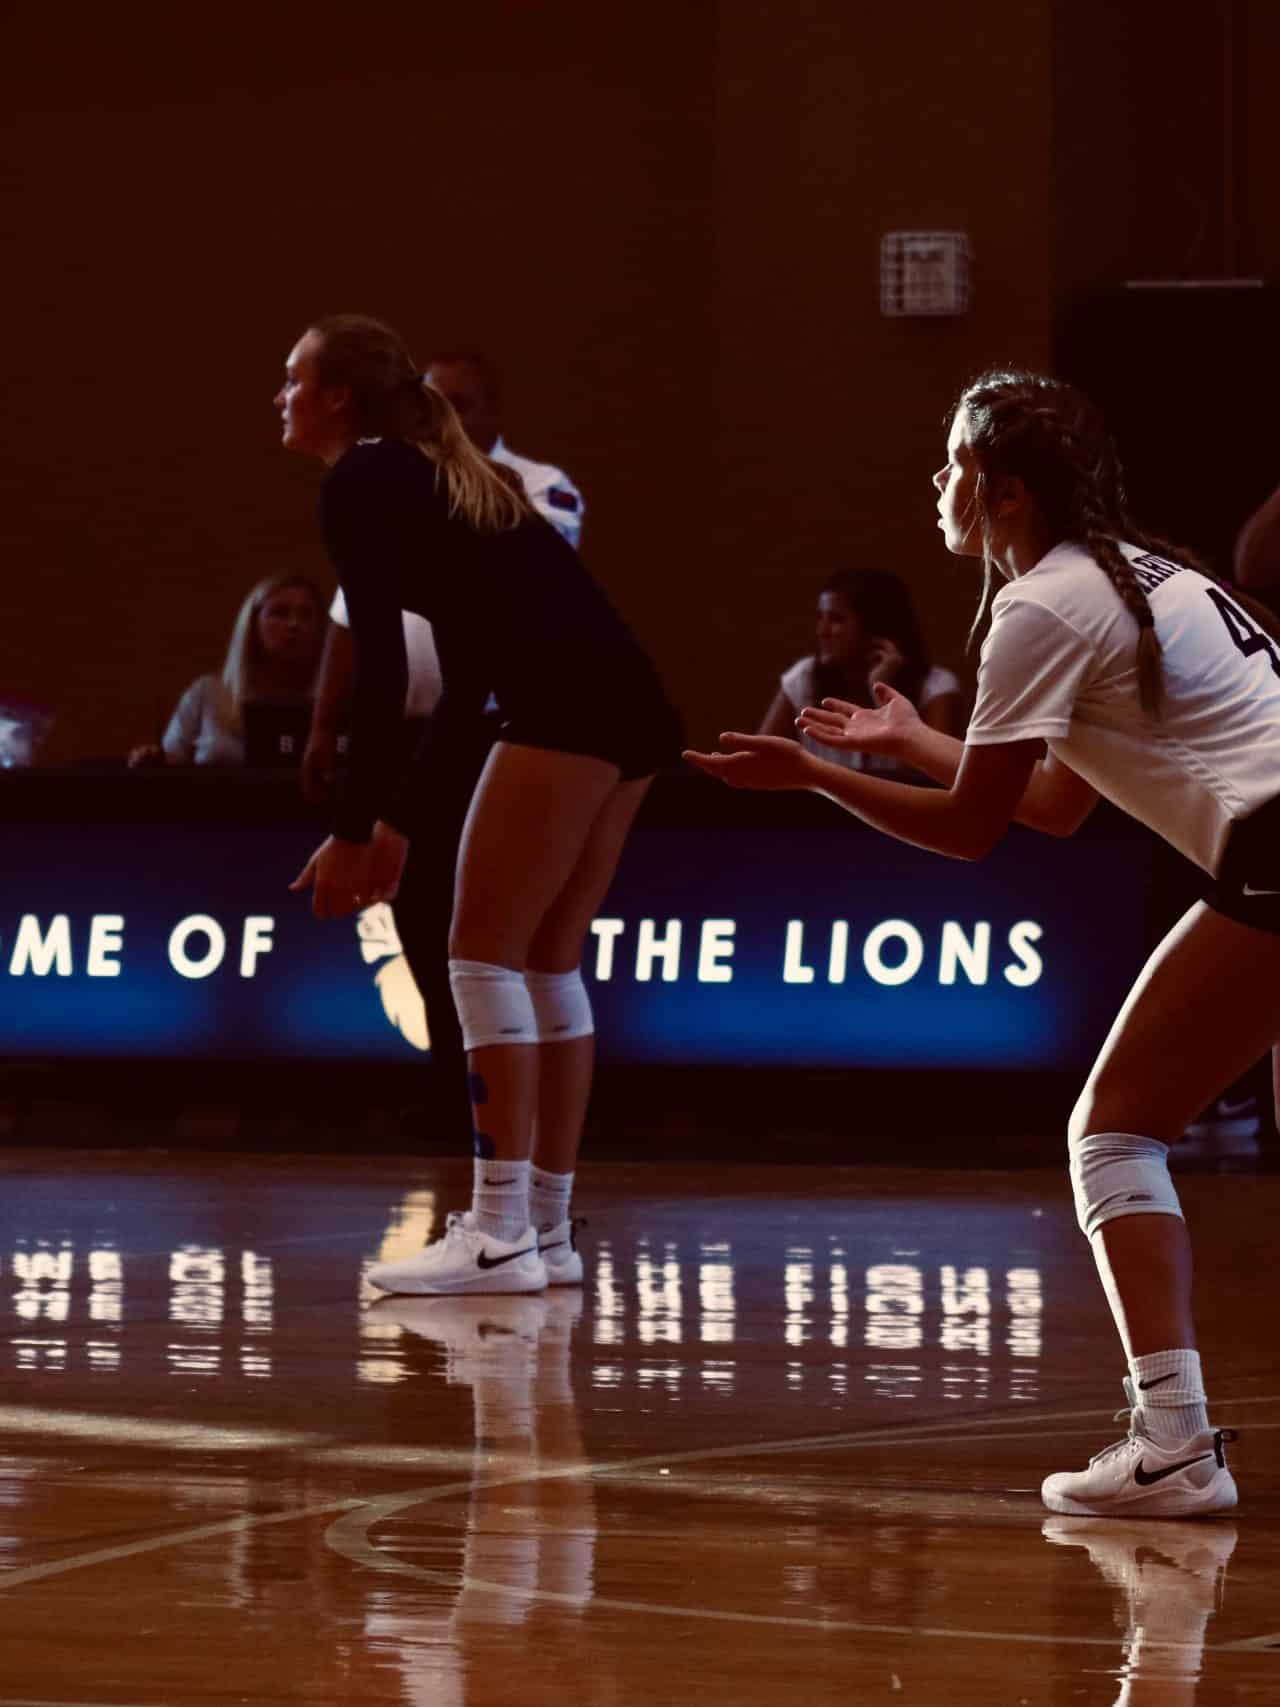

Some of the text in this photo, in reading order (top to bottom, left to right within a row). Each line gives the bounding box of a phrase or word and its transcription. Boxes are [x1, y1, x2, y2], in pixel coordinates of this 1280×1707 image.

[0, 914, 1044, 988] ME OF THE LIONS
